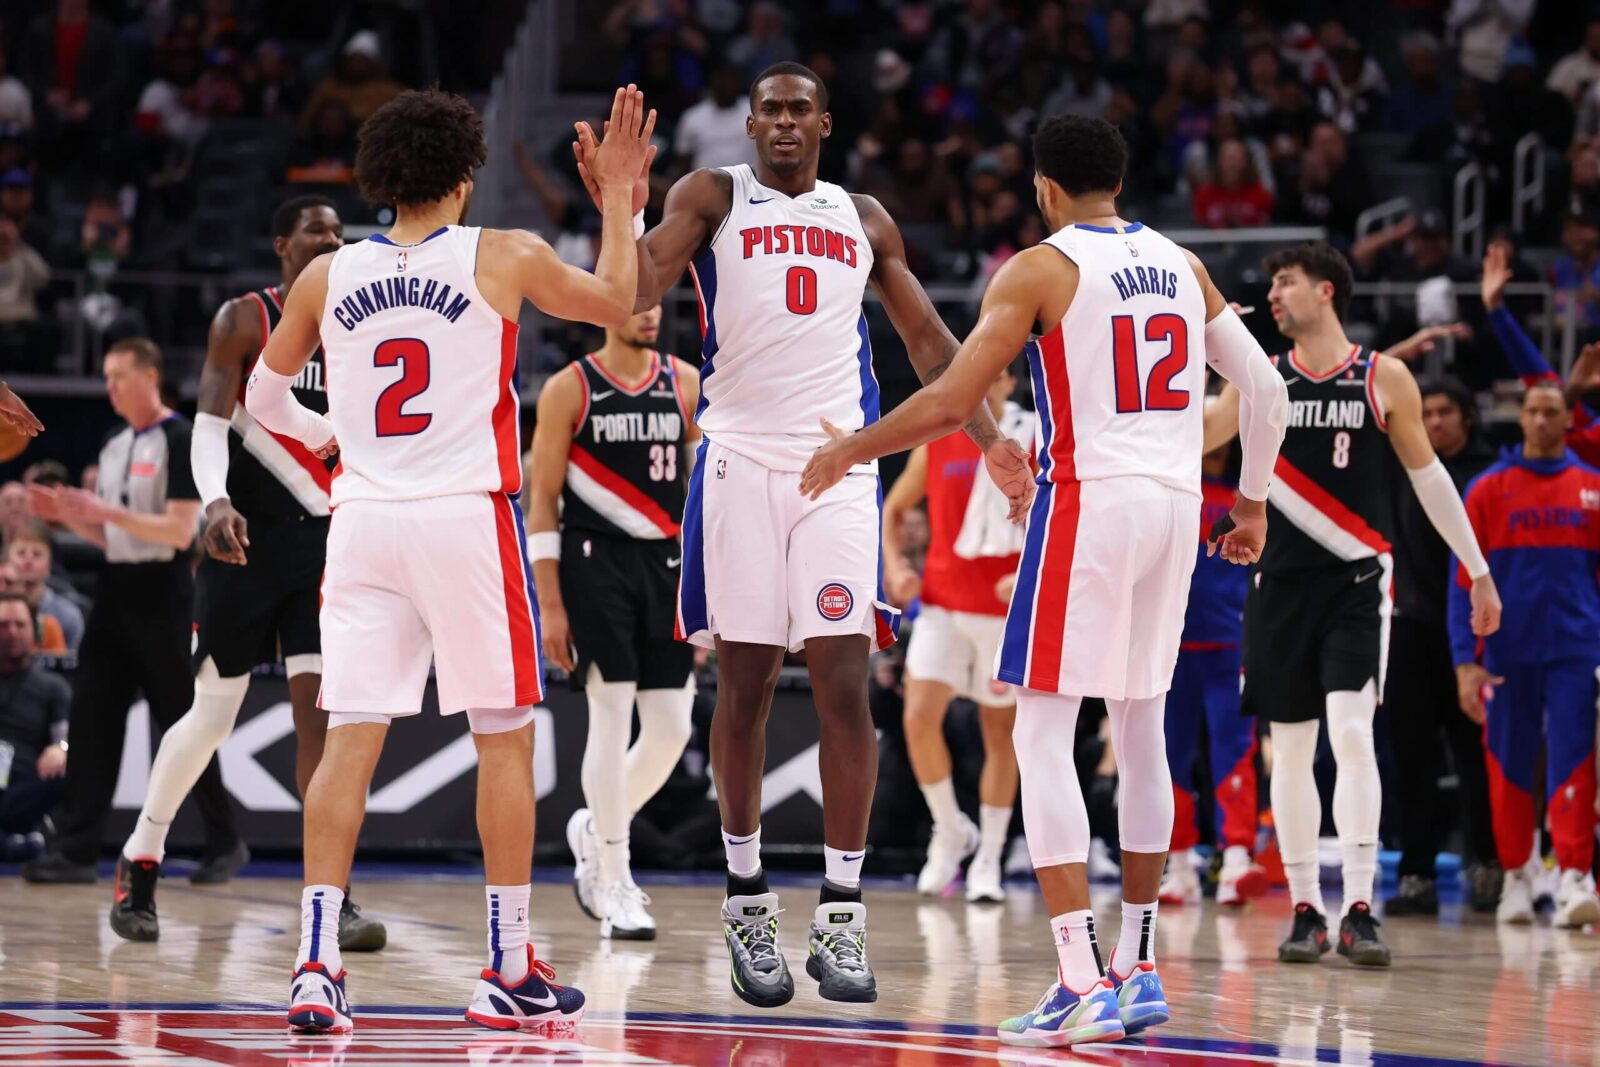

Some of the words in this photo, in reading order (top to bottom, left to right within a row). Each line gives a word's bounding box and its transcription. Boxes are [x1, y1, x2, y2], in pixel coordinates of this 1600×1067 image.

[739, 224, 858, 268] PISTONS
[333, 276, 471, 331] CUNNINGHAM
[786, 266, 817, 315] 0
[1110, 265, 1178, 301] HARRIS
[1111, 313, 1190, 413] 12
[374, 338, 433, 437] 2
[590, 412, 681, 442] PORTLAND
[649, 445, 676, 481] 33
[1332, 431, 1350, 469] 8
